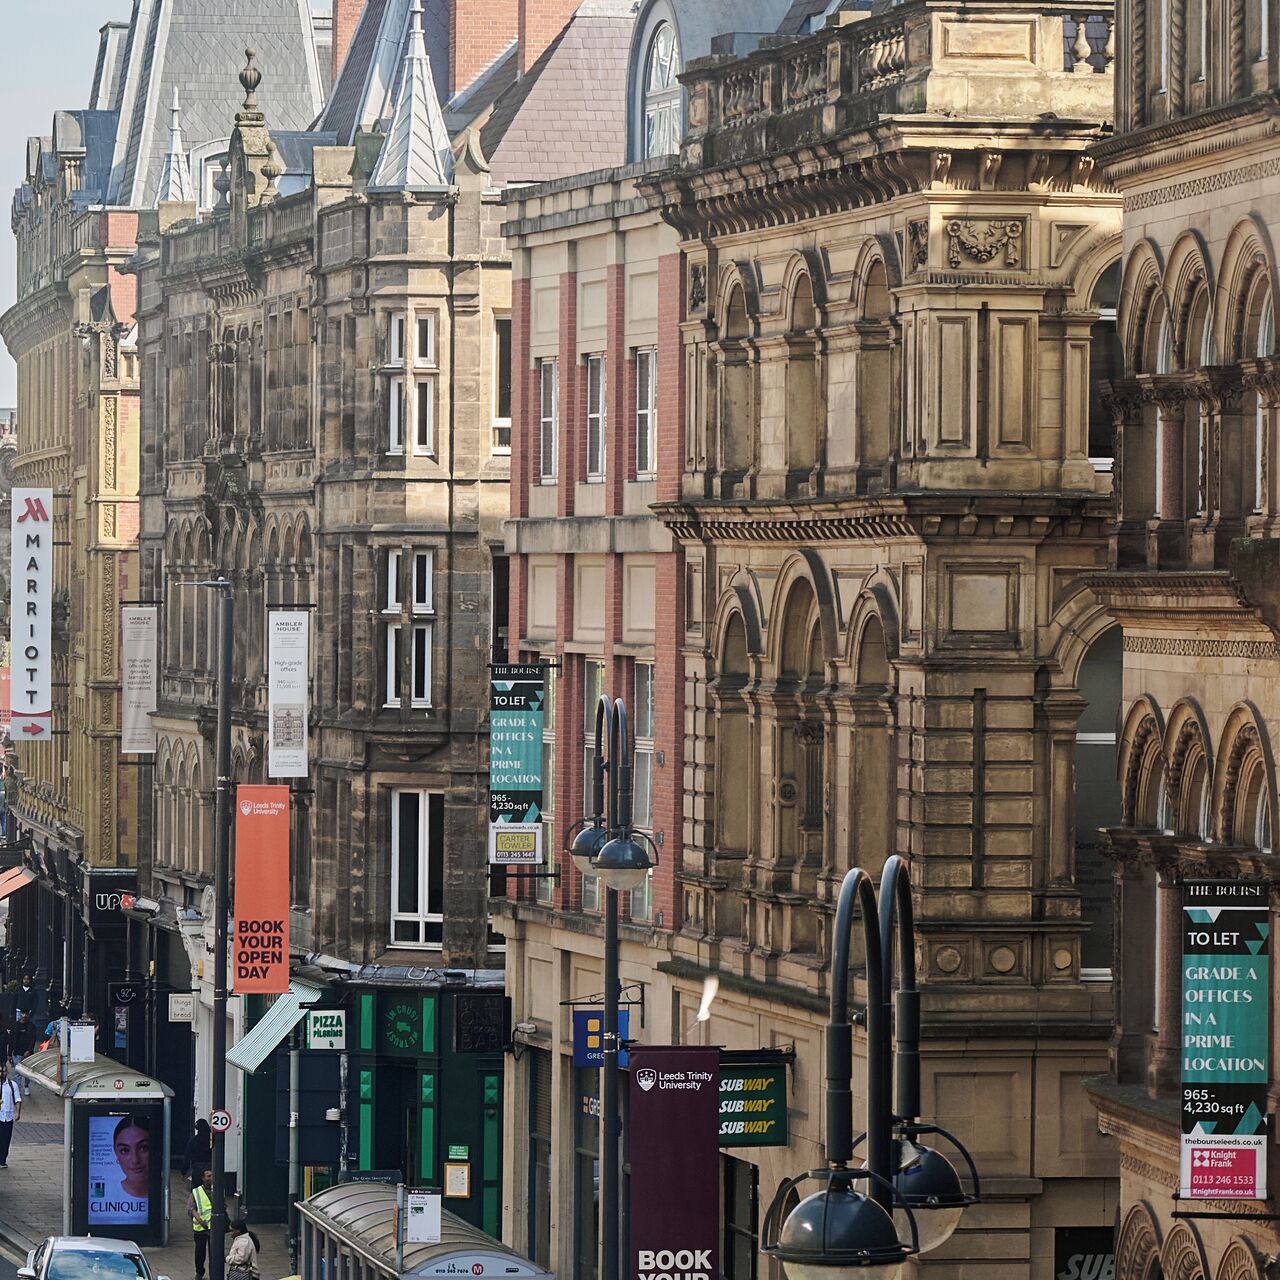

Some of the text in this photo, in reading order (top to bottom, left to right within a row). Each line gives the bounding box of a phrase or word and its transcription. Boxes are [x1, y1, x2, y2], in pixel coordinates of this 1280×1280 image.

[25, 533, 41, 705] MARRIOTT
[494, 696, 526, 706] TO LET
[492, 718, 537, 727] GRADE A
[492, 732, 534, 741] OFFICES
[492, 760, 523, 769] PRIME
[492, 775, 541, 784] LOCATION
[253, 808, 279, 816] University
[269, 802, 286, 810] Trinity
[491, 802, 514, 811] 4,230
[499, 842, 533, 850] TOWLER
[1188, 886, 1264, 896] THE BOURSE
[95, 893, 121, 911] UP
[238, 920, 285, 934] BOOK
[238, 935, 283, 949] YOUR
[1188, 932, 1240, 946] TO LET
[237, 951, 283, 964] OPEN
[238, 966, 271, 979] DAY
[1185, 967, 1258, 981] GRADE A
[1185, 989, 1253, 1003] OFFICES
[313, 1015, 343, 1028] PIZZA
[1185, 1012, 1217, 1025] IN A
[1184, 1035, 1236, 1048] PRIME
[1184, 1057, 1265, 1071] LOCATION
[658, 1071, 713, 1084] Leeds Trinity
[658, 1080, 702, 1092] University
[719, 1077, 774, 1092] SUBWAY
[1183, 1089, 1209, 1101] 965
[719, 1099, 775, 1114] SUBWAY
[1183, 1102, 1244, 1116] 4,230 sq ft
[212, 1115, 228, 1126] 20
[719, 1120, 775, 1135] SUBWAY
[1210, 1150, 1237, 1160] Knight
[1210, 1159, 1233, 1168] Frank
[1193, 1176, 1254, 1185] 0113 246 1533
[90, 1201, 146, 1214] CLINIQUE
[637, 1249, 713, 1271] BOOK
